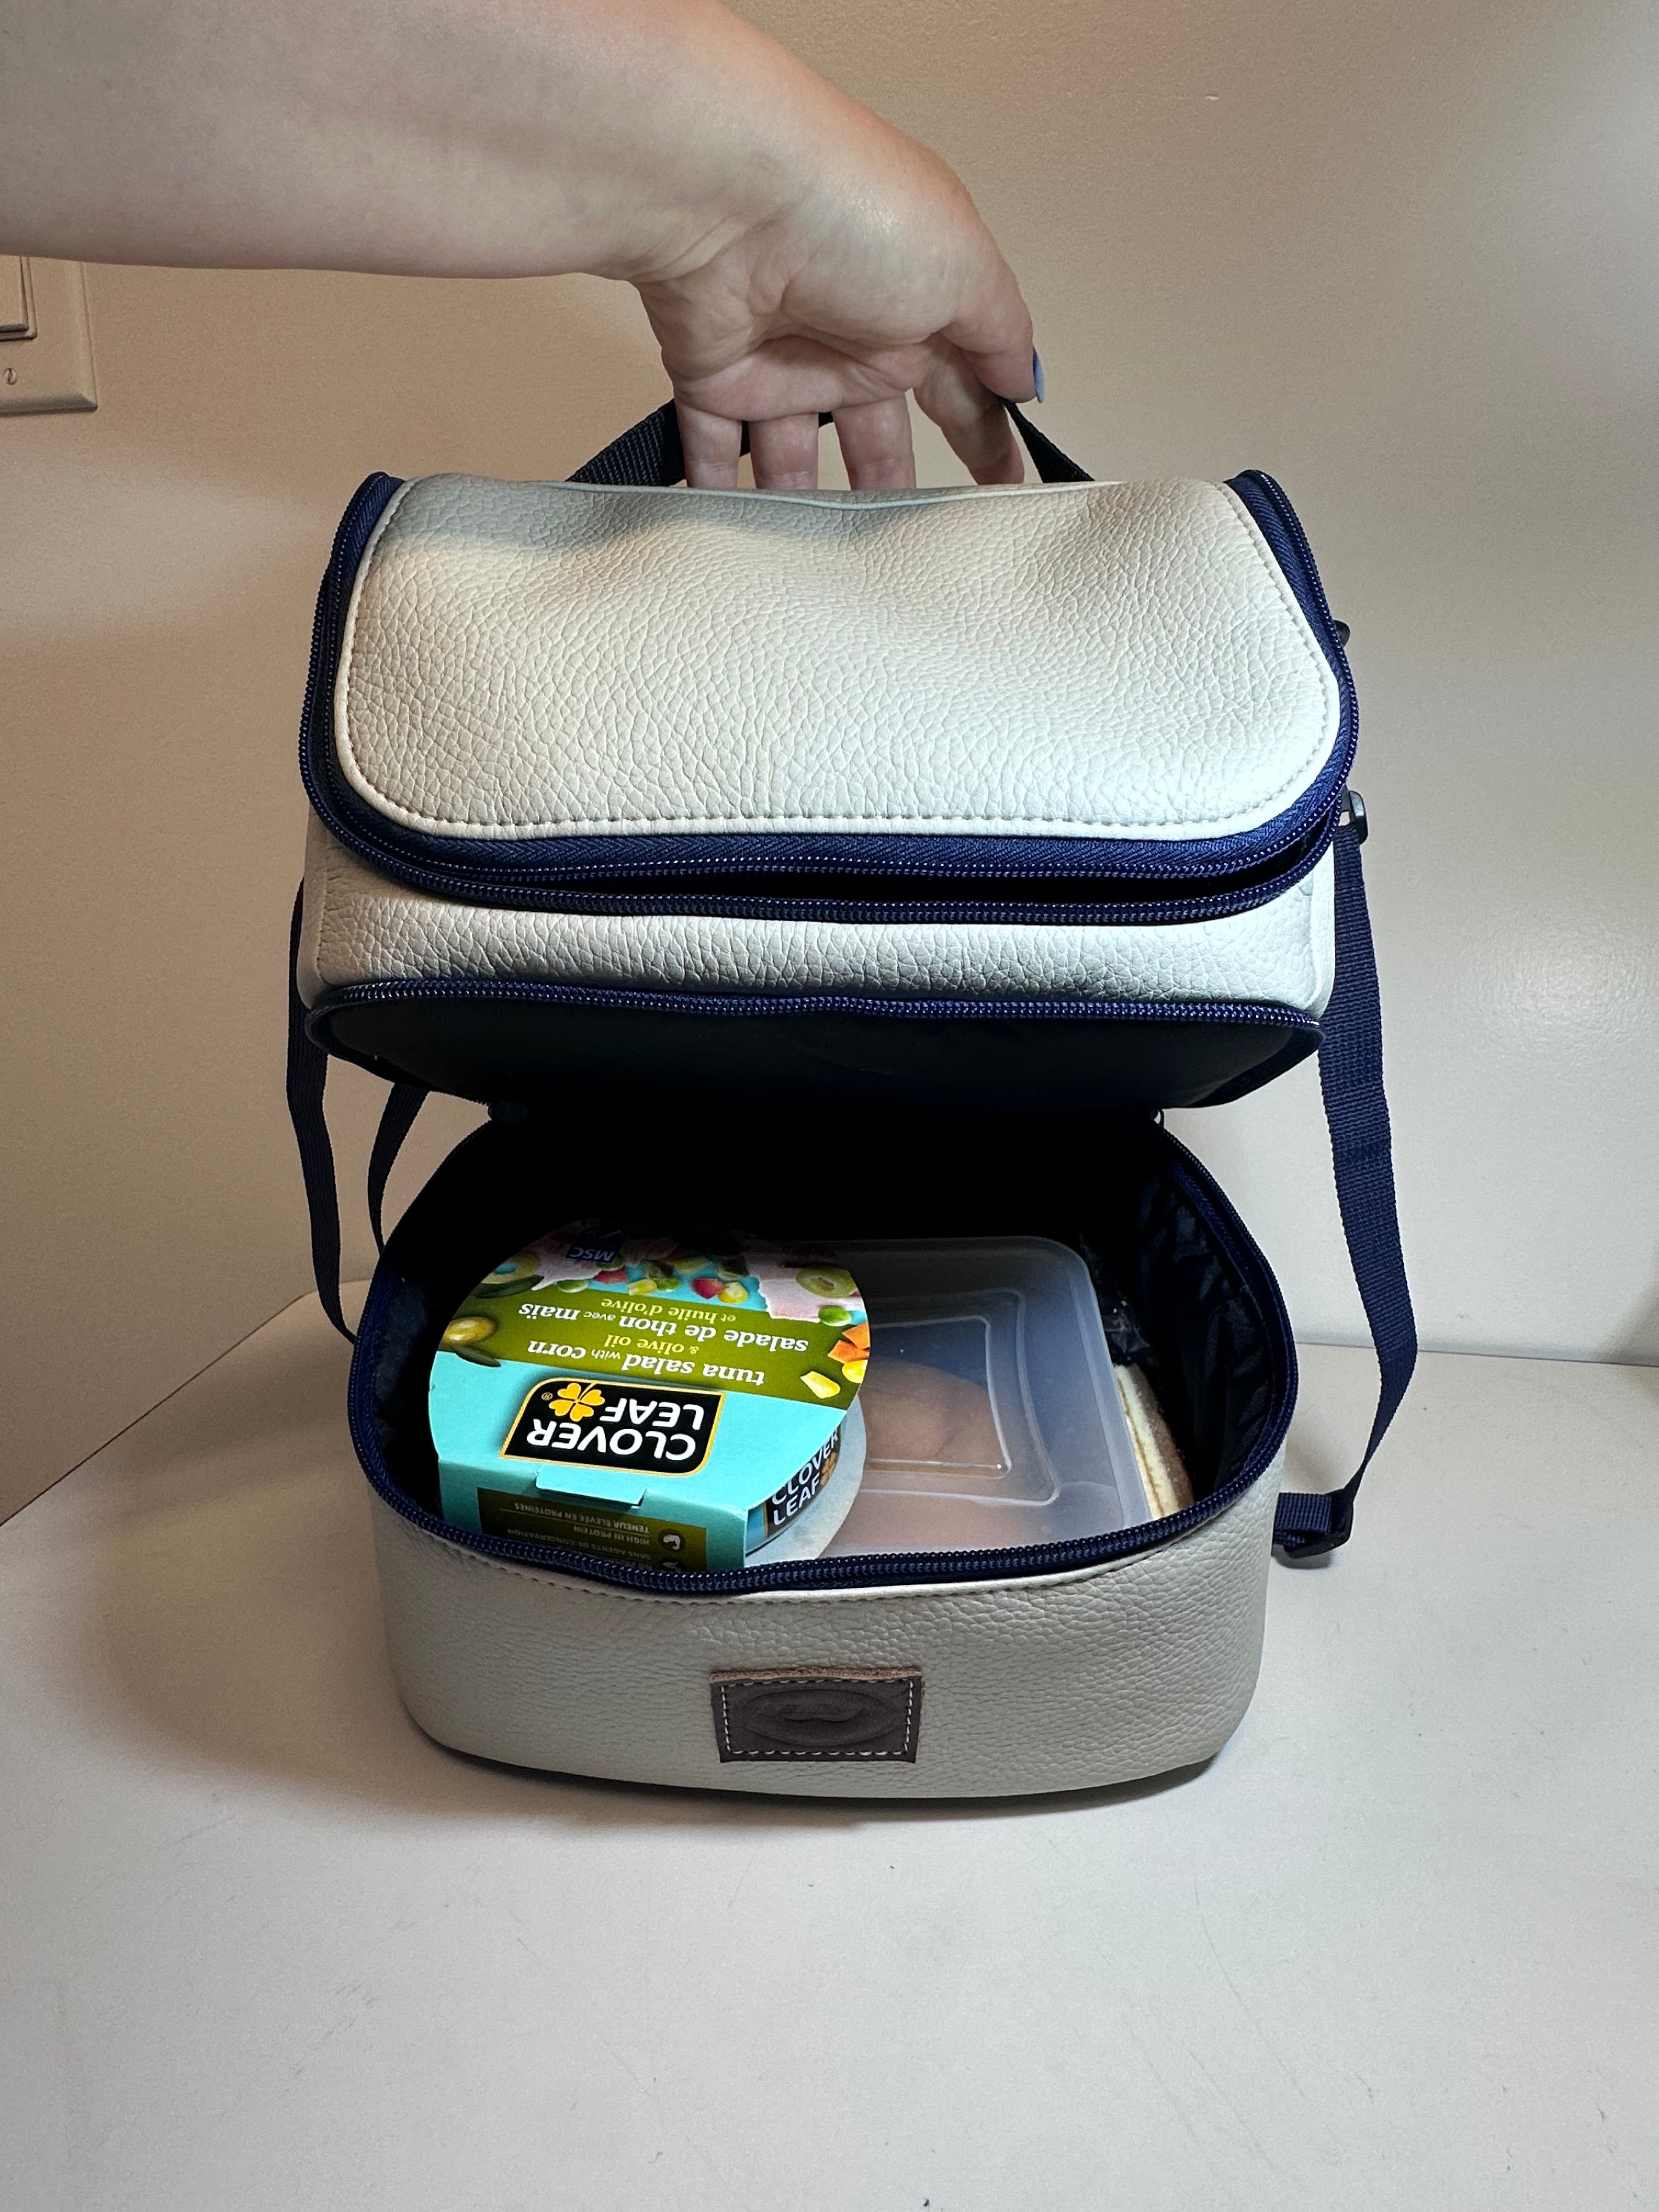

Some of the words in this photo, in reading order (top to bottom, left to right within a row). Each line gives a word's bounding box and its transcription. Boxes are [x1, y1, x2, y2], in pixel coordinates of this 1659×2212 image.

[568, 1246, 615, 1262] MSC
[518, 1304, 581, 1321] maïs
[601, 1298, 663, 1316] d'olive
[668, 1307, 718, 1324] huile
[583, 1311, 616, 1321] avec
[721, 1314, 736, 1322] et
[619, 1316, 677, 1336] thon
[685, 1324, 716, 1342] de
[604, 1334, 631, 1347] oil
[636, 1339, 685, 1355] olive
[723, 1329, 809, 1352] salade
[528, 1341, 586, 1359] corn
[591, 1349, 621, 1360] with
[689, 1345, 700, 1355] &
[621, 1354, 696, 1375] salad
[702, 1364, 765, 1386] tuna
[600, 1398, 704, 1431] LEAF
[527, 1419, 696, 1460] CLOVER
[774, 1472, 820, 1525] LEAF
[613, 1520, 650, 1534] TENEUR
